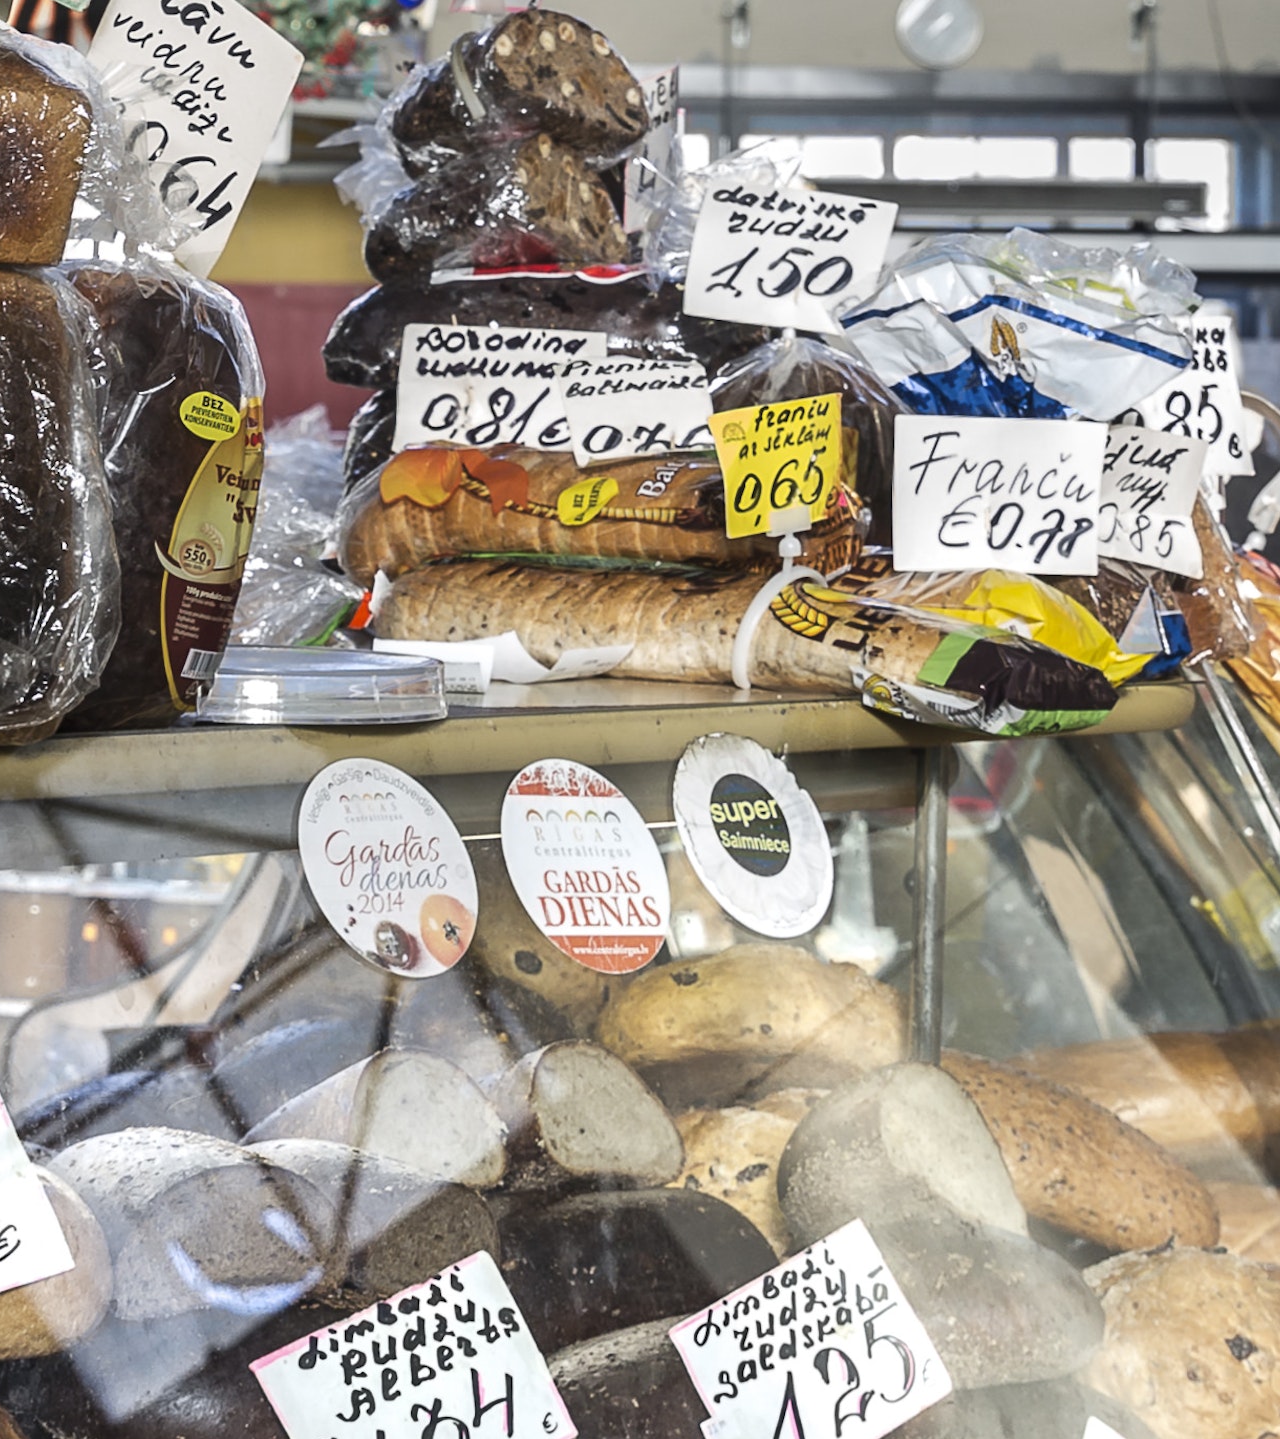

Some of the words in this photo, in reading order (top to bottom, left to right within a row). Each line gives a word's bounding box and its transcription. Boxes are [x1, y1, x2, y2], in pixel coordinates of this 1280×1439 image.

[202, 395, 224, 412] BEZ
[183, 547, 207, 564] 550
[709, 797, 779, 827] super
[718, 829, 791, 855] Saimniece
[359, 855, 448, 897] dienas
[543, 865, 642, 894] GARDĀS
[357, 890, 405, 915] 2014
[537, 895, 663, 928] DIENAS
